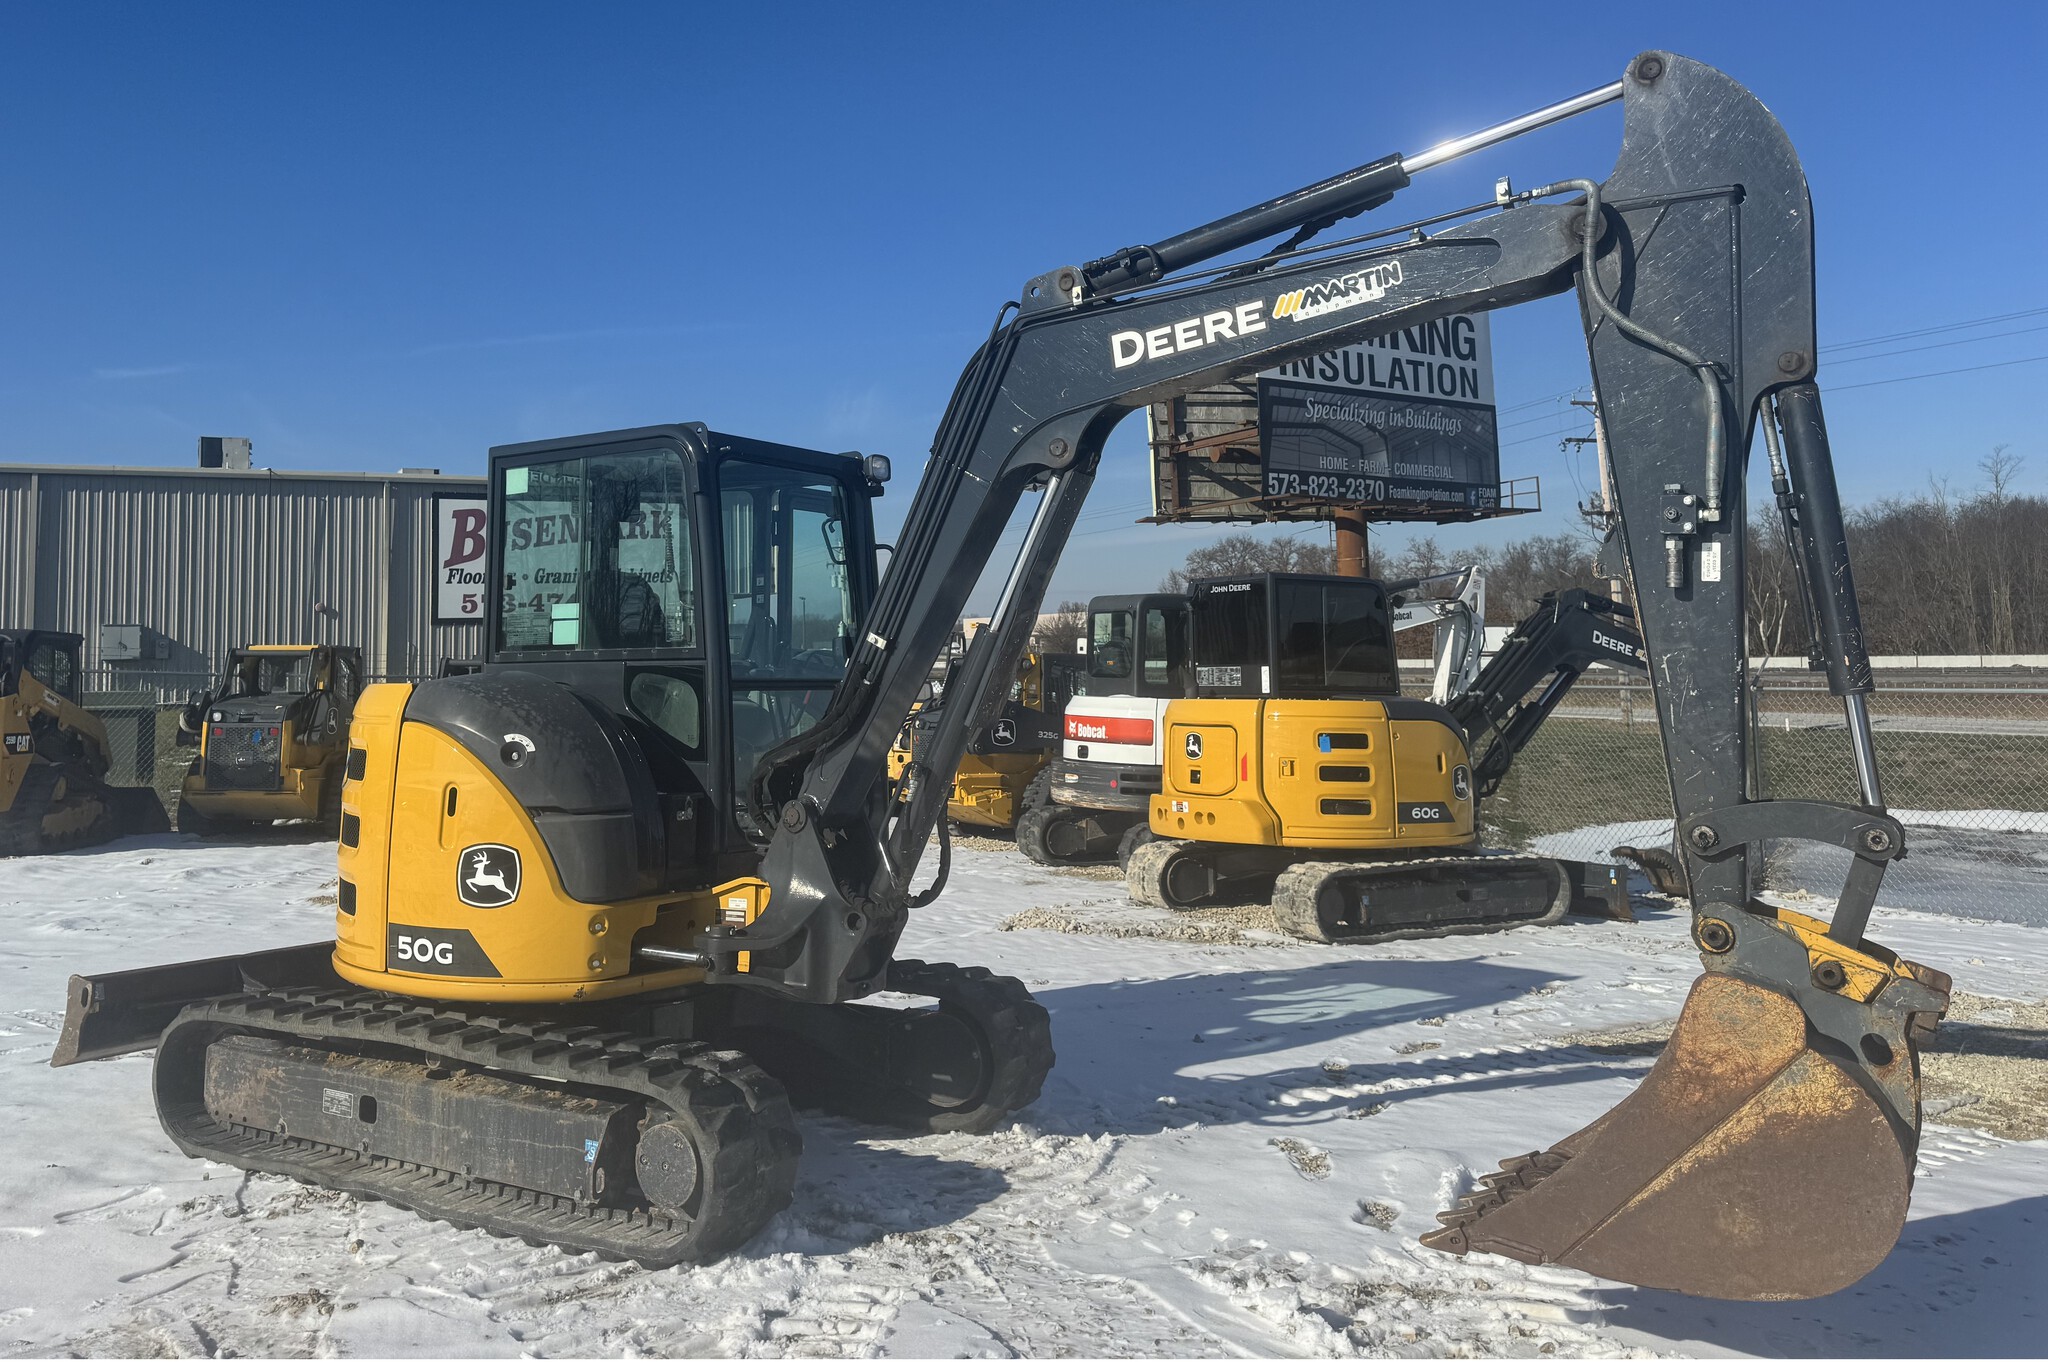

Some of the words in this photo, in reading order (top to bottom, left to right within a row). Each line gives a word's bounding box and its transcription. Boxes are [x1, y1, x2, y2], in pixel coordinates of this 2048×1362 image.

[1300, 262, 1401, 310] MARTIN
[1294, 289, 1384, 320] Equipment
[1111, 300, 1267, 369] DEERE
[1305, 397, 1385, 430] Specializing
[1389, 410, 1402, 426] in
[1406, 408, 1462, 437] Buildings
[1319, 456, 1349, 470] HOME
[1358, 459, 1385, 475] FARM
[1394, 462, 1454, 479] COMMERCIAL
[1268, 472, 1385, 502] 573-823-2370
[1389, 484, 1465, 503] Foamkinginsulation.com
[1478, 487, 1497, 498] FOAM
[1210, 585, 1228, 593] JOHN
[1228, 584, 1251, 592] DEERE
[1394, 610, 1413, 621] obcat
[1592, 629, 1634, 657] DEERE
[1037, 730, 1059, 740] 325G
[1077, 723, 1107, 739] Bobcat
[16, 735, 30, 752] CAT
[1411, 807, 1440, 819] 60G
[397, 935, 453, 965] 50G
